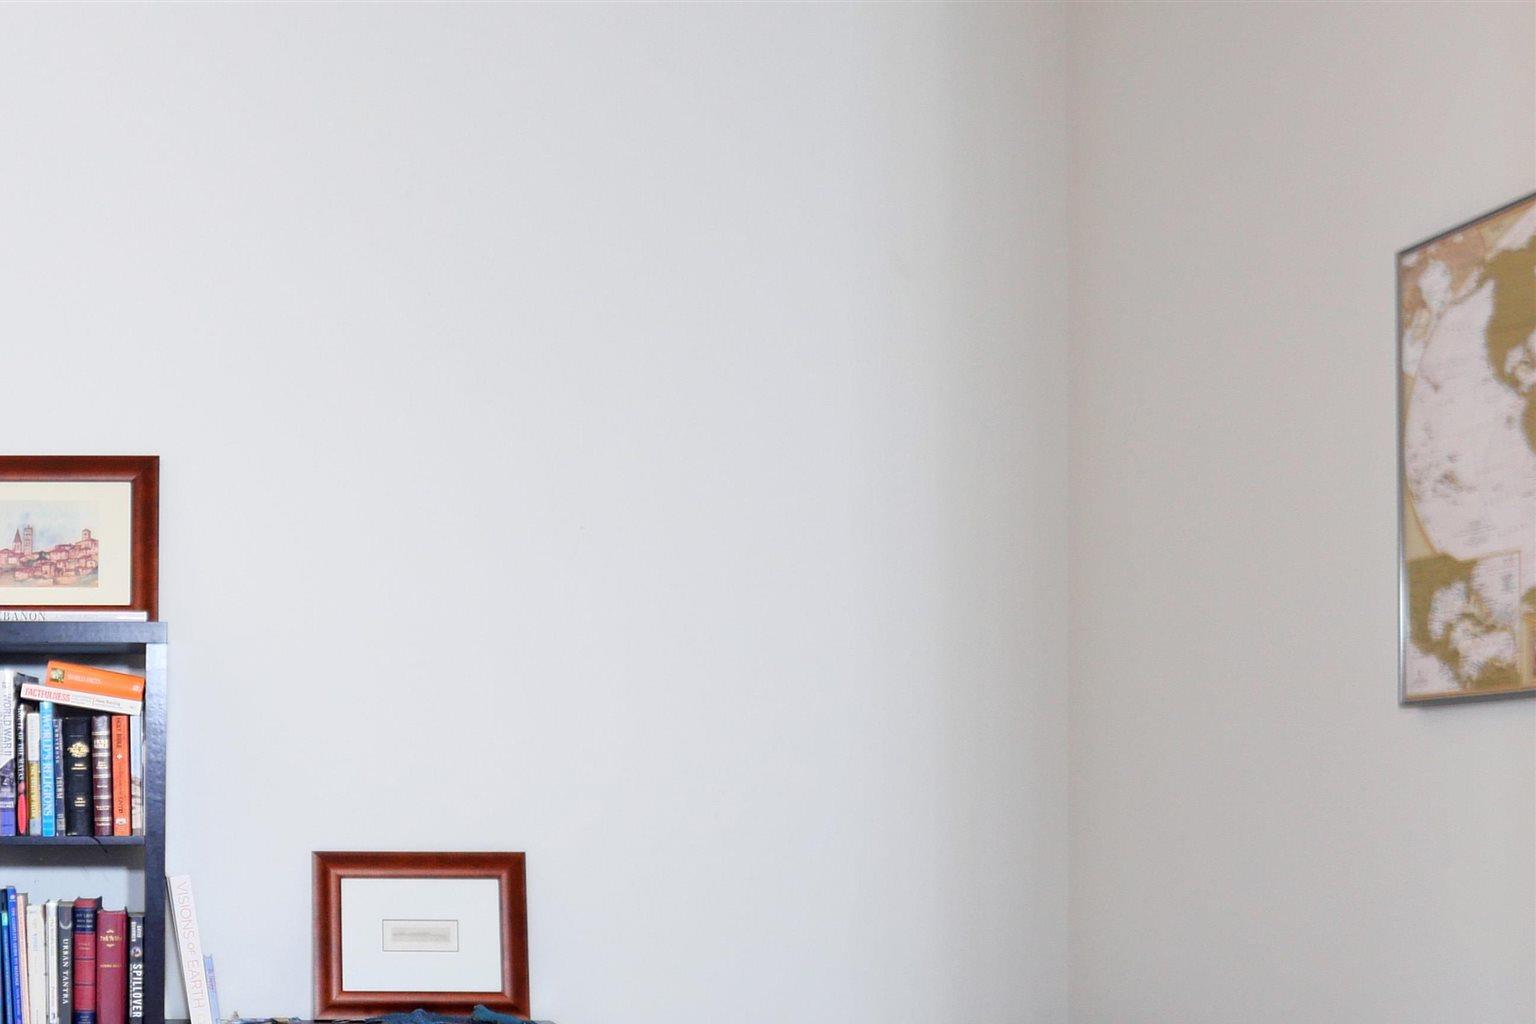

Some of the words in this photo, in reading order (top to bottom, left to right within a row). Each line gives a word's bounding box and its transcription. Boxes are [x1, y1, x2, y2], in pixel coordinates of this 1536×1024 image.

[3, 692, 12, 725] WORLD
[3, 727, 12, 748] WAR
[43, 714, 53, 760] WORLD'S
[43, 763, 53, 816] RELIGIONS
[176, 881, 195, 939] VISIONS
[187, 960, 204, 1009] EARTH
[132, 964, 142, 1018] SPILLOVER
